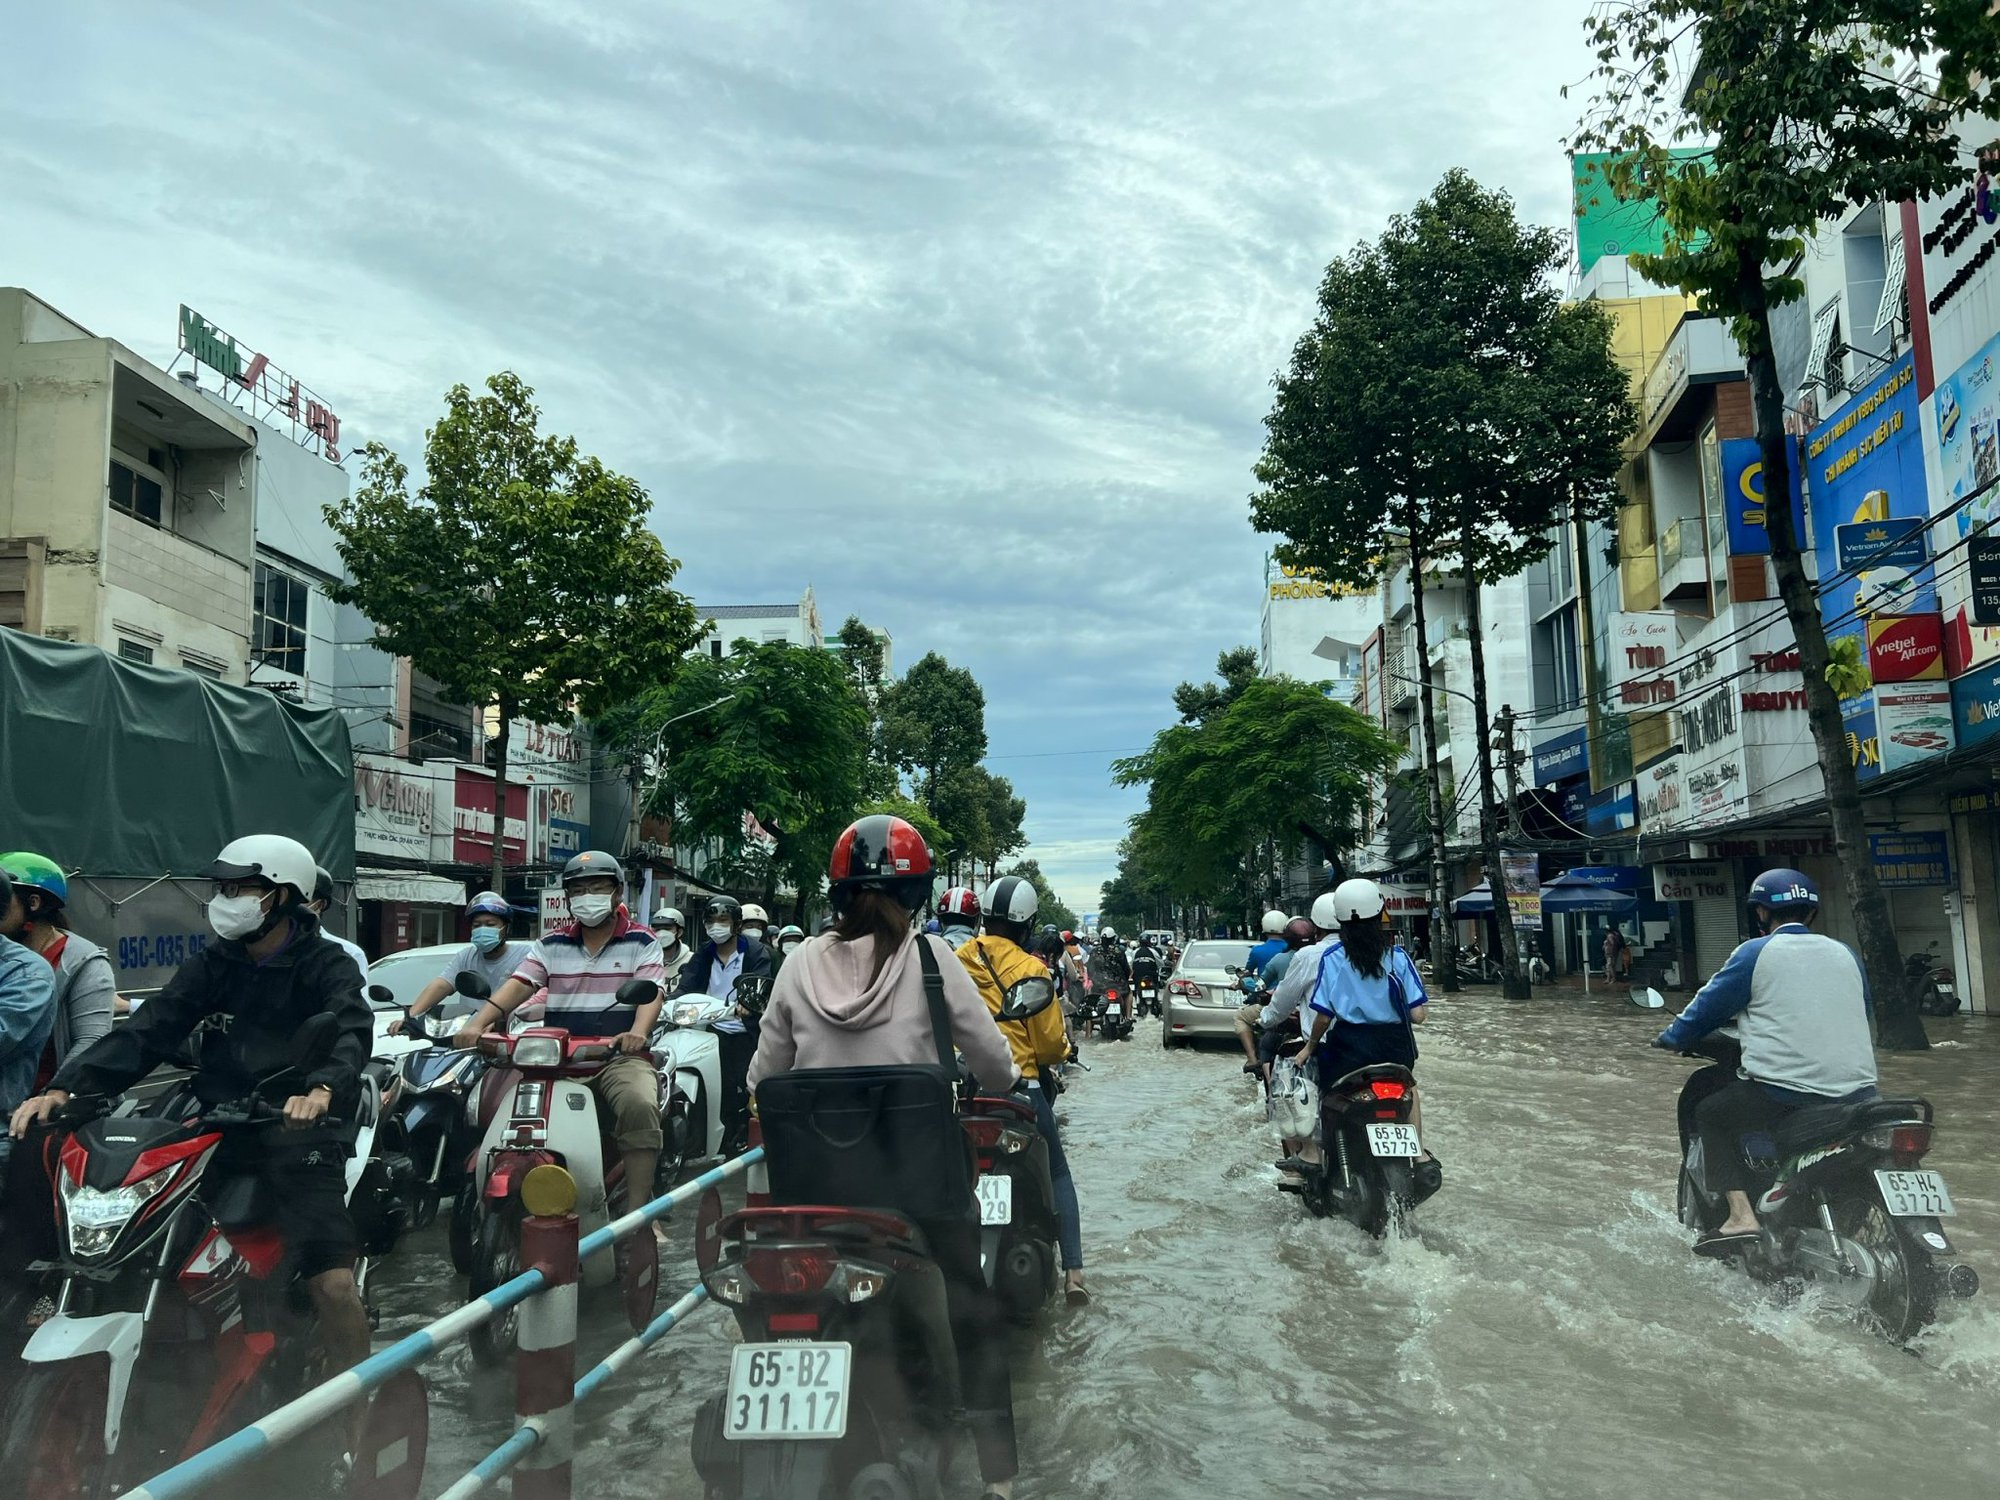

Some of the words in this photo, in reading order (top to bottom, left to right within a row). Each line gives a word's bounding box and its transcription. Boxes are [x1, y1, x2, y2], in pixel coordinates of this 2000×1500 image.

[1899, 364, 1913, 387] SJC
[1860, 435, 1874, 458] SJC
[1846, 542, 1879, 551] Vietnam
[1626, 643, 1665, 669] TÙNG
[1749, 651, 1801, 673] TÙN
[1741, 688, 1809, 711] NGUY
[1862, 736, 1880, 767] SJC
[1791, 884, 1808, 898] ila
[1375, 1127, 1410, 1140] 65-B2
[1375, 1142, 1418, 1154] 157.79
[976, 1180, 999, 1200] -K1
[1888, 1173, 1937, 1192] 65-H4
[981, 1201, 1007, 1220] .29
[1895, 1194, 1947, 1212] 3722
[749, 1350, 831, 1388] 65-B2
[734, 1391, 840, 1431] 311.17
